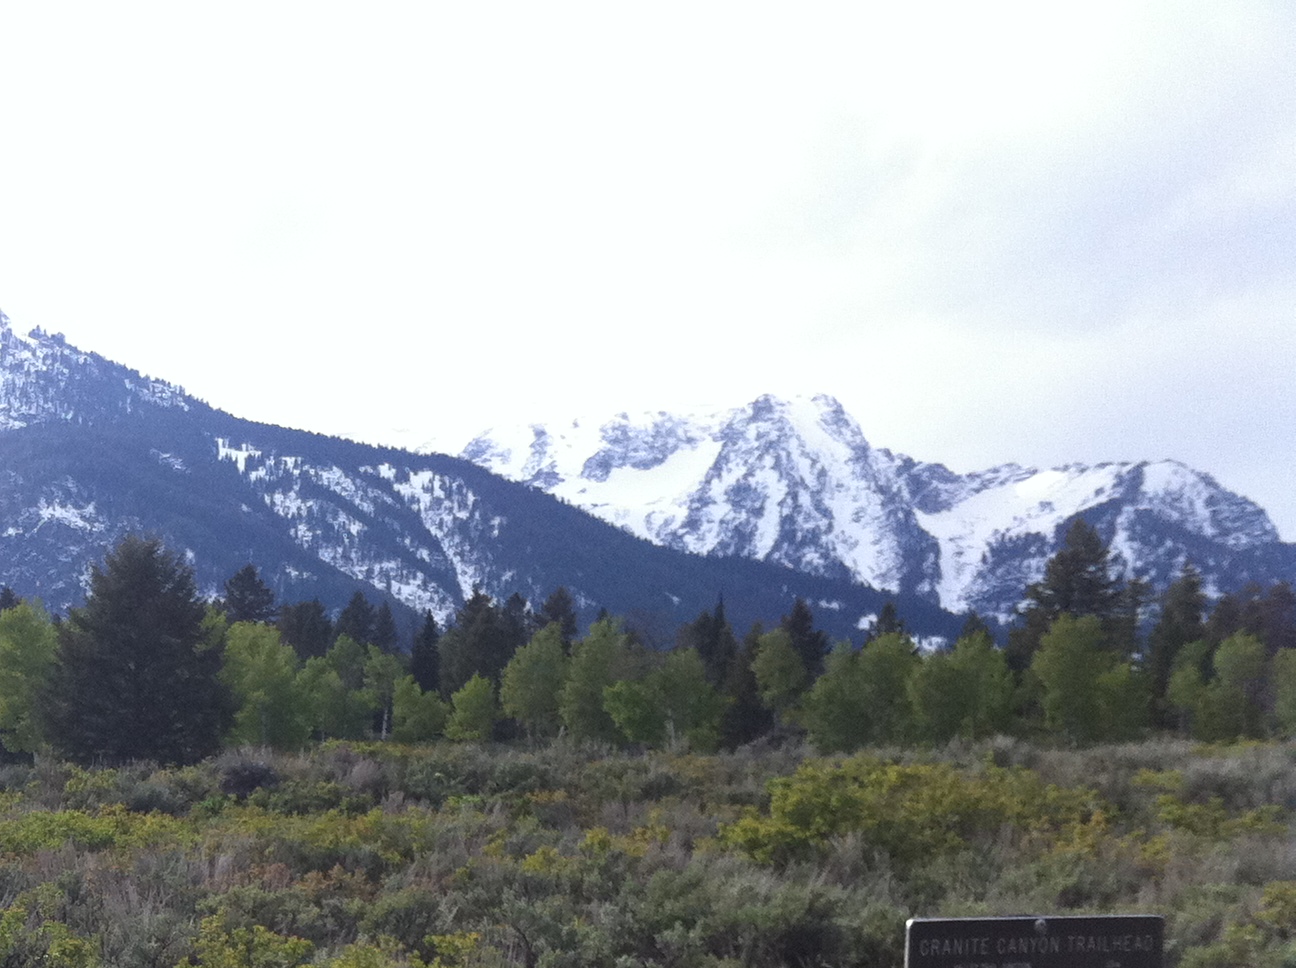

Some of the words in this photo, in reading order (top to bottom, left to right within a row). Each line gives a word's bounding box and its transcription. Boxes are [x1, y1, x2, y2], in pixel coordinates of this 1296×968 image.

[919, 937, 990, 956] GRANITE
[997, 935, 1060, 954] CANYON
[1067, 934, 1154, 952] TRAILHEAD
